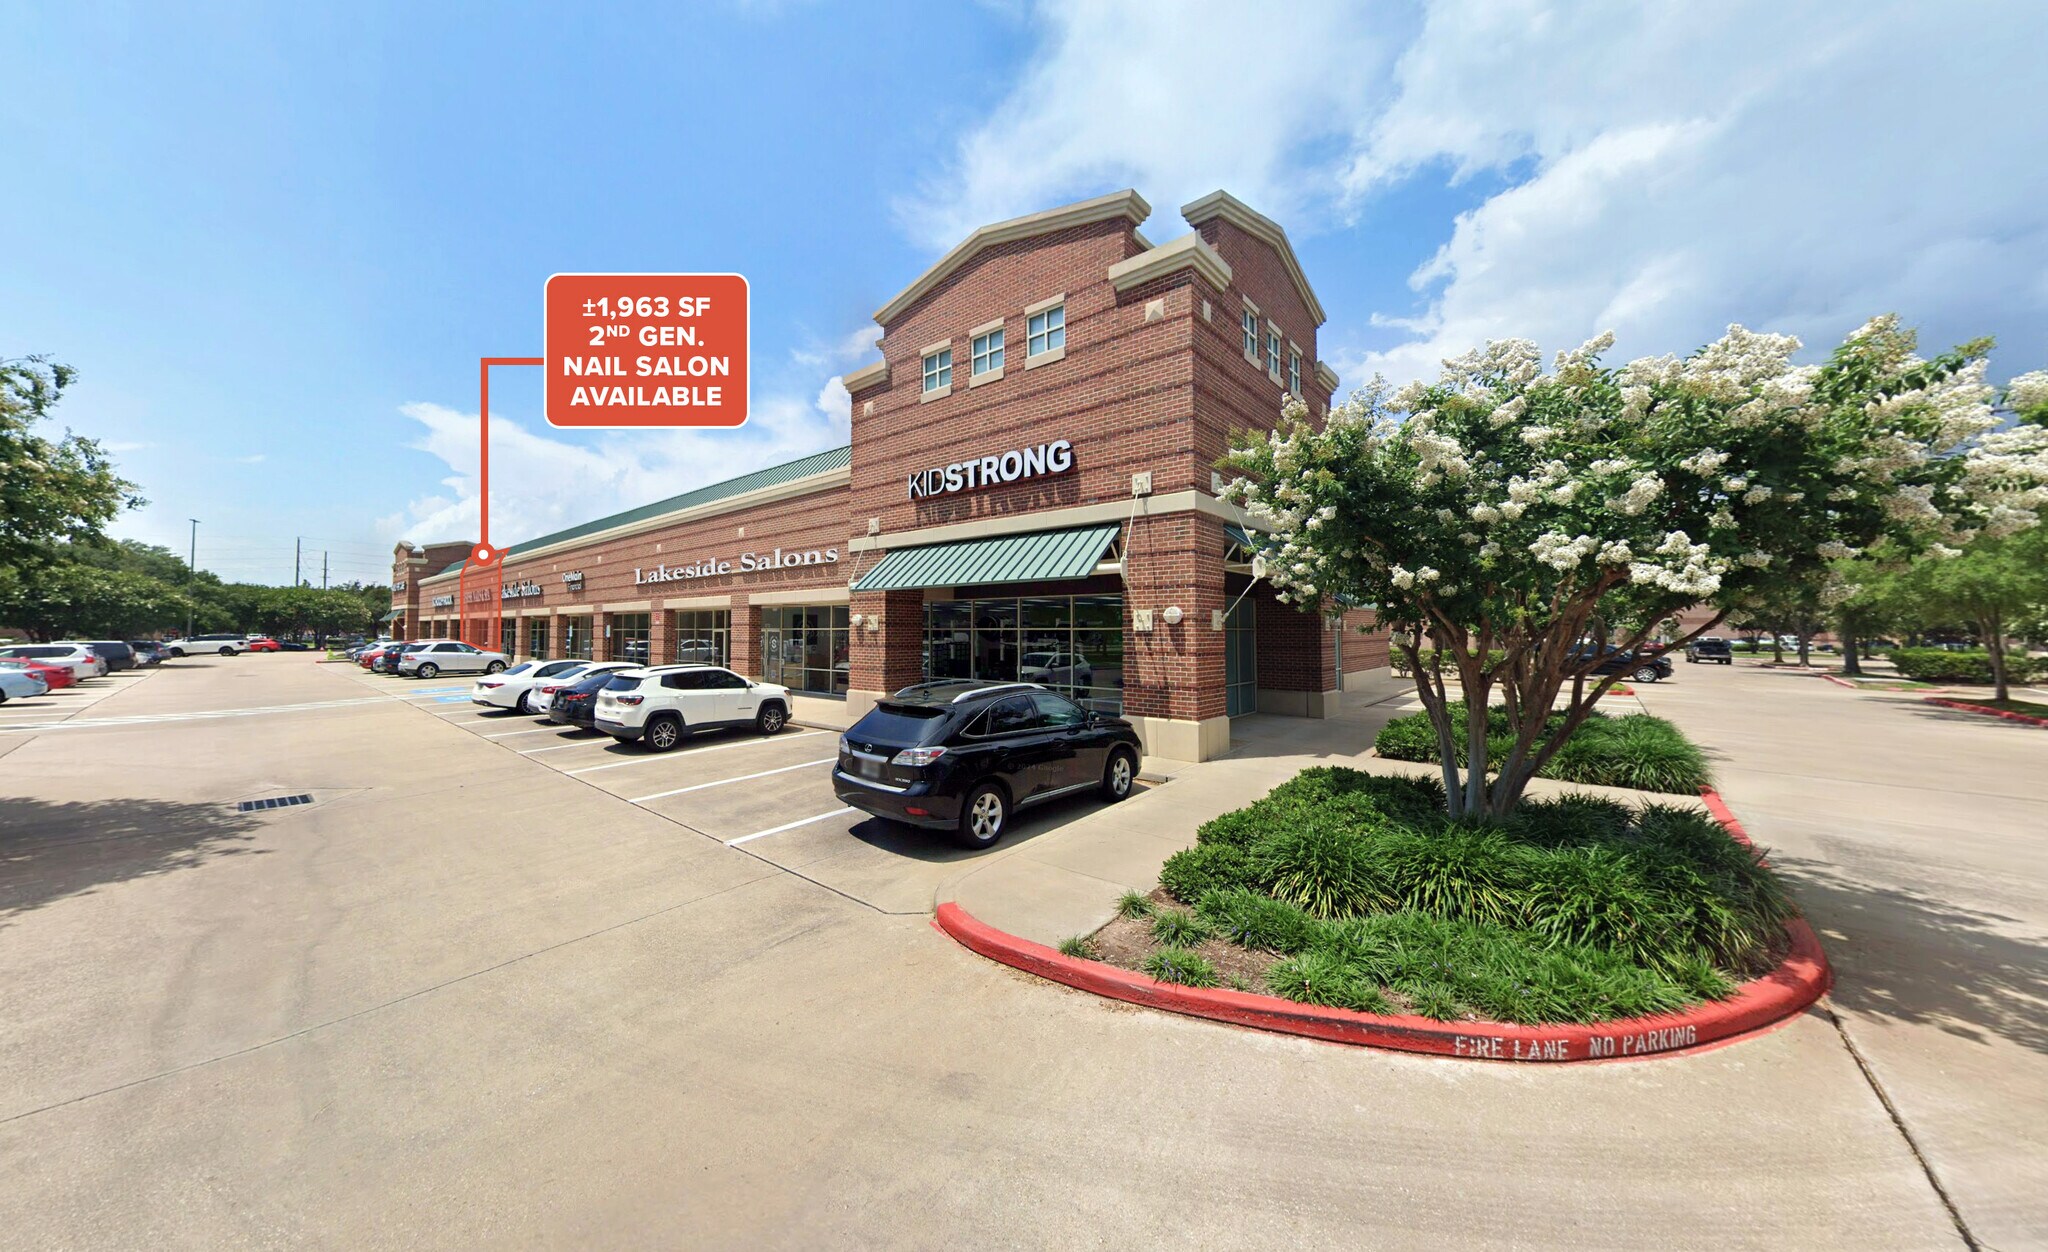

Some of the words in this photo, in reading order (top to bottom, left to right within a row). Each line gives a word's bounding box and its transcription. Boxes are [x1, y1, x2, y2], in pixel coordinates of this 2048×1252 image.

[907, 439, 1073, 499] KIDSTRONG
[634, 556, 732, 586] Lakeside
[739, 547, 839, 573] Salons
[1454, 1034, 1504, 1058] FIRE
[1512, 1038, 1570, 1060] LANE
[1588, 1035, 1616, 1058] NO
[1621, 1024, 1697, 1056] PARKING
